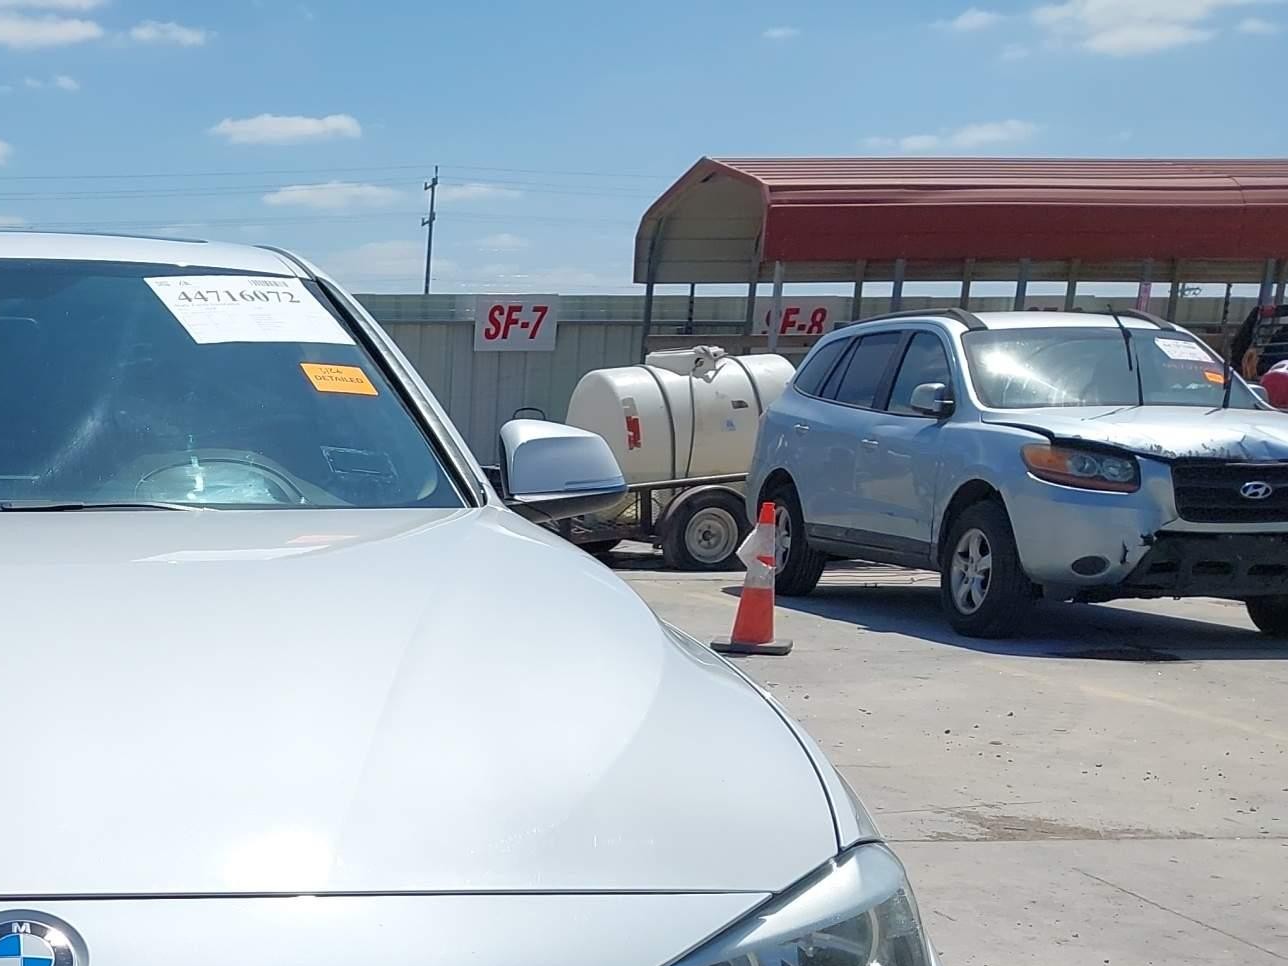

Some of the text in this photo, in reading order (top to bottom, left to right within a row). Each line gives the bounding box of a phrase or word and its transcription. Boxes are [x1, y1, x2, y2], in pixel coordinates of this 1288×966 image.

[177, 289, 301, 303] 44716072
[484, 304, 549, 340] SF-7
[314, 374, 364, 384] DETAILED
